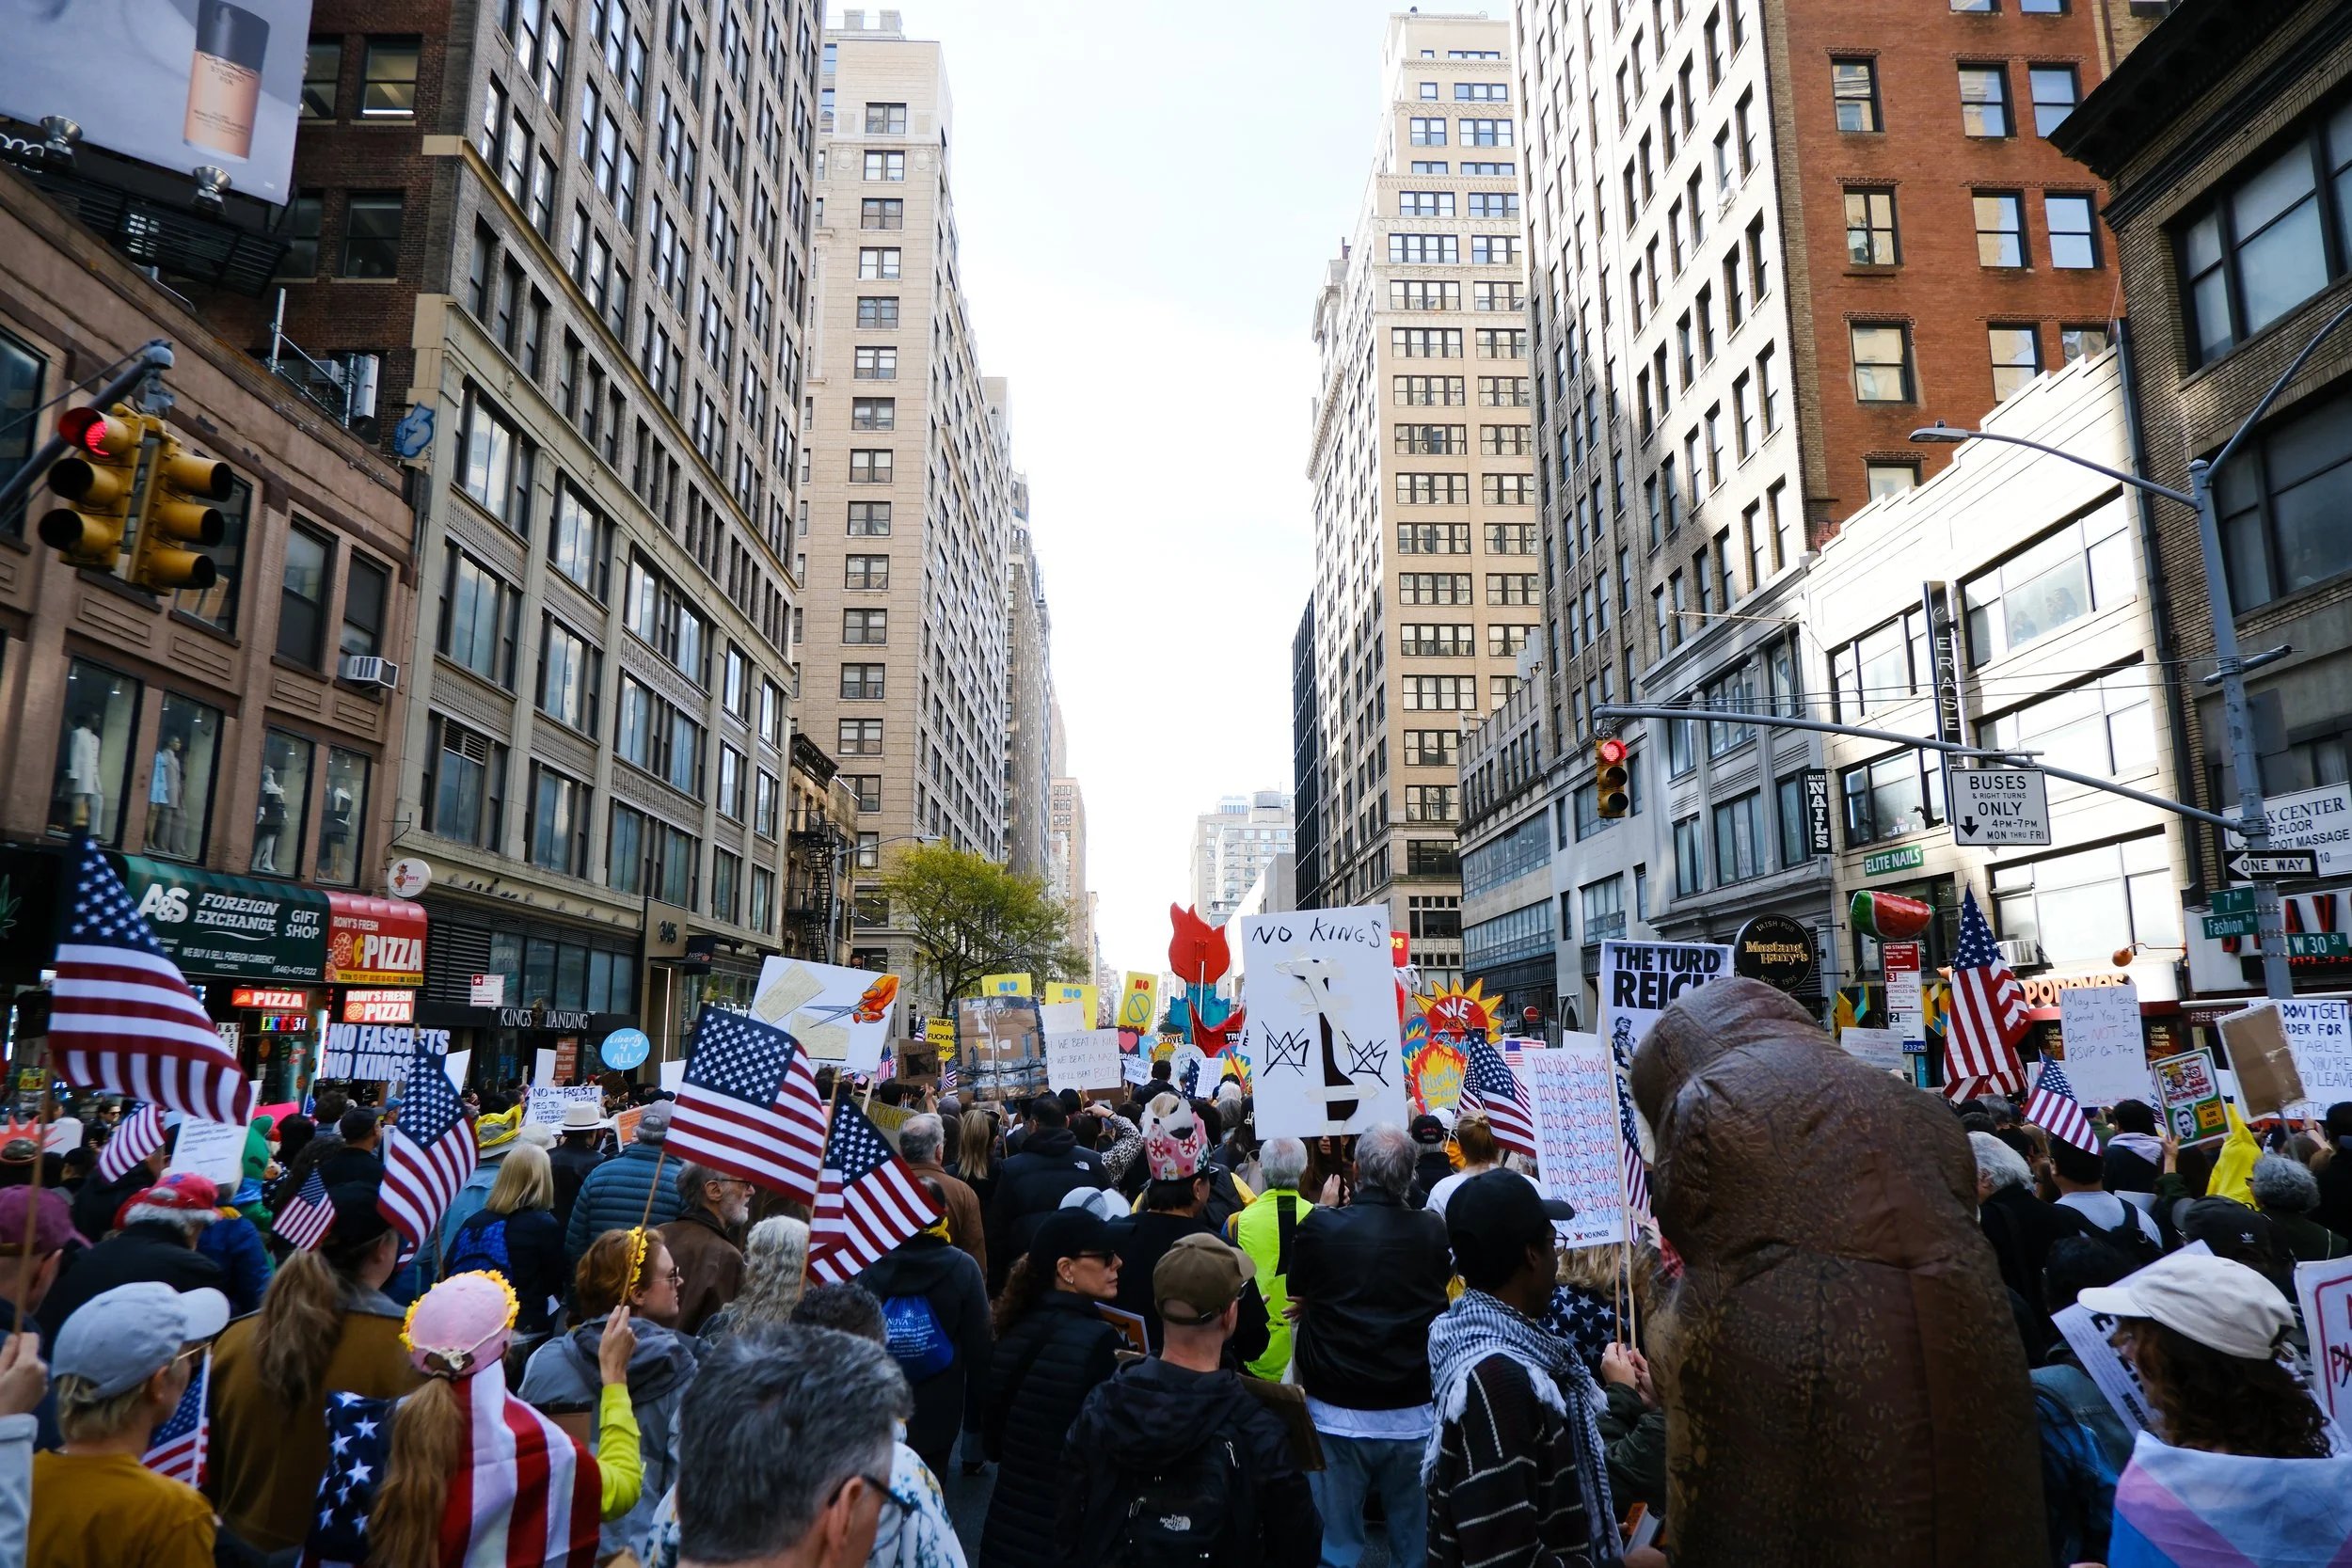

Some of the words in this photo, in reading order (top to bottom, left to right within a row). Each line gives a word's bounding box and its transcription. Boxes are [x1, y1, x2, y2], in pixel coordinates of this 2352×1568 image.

[1969, 776, 2026, 789] BUSES
[1808, 782, 1828, 848] NAILS
[1978, 801, 2022, 816] ONLY
[2279, 797, 2345, 821] CENTER
[1992, 819, 2037, 828] 4PM-7PM
[2279, 819, 2313, 833] FLOOR
[1987, 831, 2007, 839] MON
[2029, 831, 2044, 839] FRI
[2296, 829, 2350, 847] MASSAGE
[1866, 856, 1890, 873] ELITE
[1892, 847, 1920, 867] NAILS
[2241, 860, 2269, 871] ONE
[2276, 859, 2303, 871] WAY
[137, 883, 190, 924] A&S
[199, 893, 280, 916] FOREIGN
[2224, 894, 2231, 910] 7
[2234, 892, 2242, 901] Av
[194, 910, 278, 931] EXCHANGE
[291, 910, 320, 925] GIFT
[333, 916, 358, 929] RONY'S
[358, 918, 379, 931] FRESH
[2208, 916, 2244, 935] Fashion
[2246, 914, 2254, 924] Av
[285, 924, 320, 940] SHOP
[660, 920, 677, 943] 345
[1252, 926, 1293, 944] NO
[1310, 917, 1381, 948] KINGS
[1756, 921, 1777, 931] IRISH
[1781, 923, 1795, 932] PUB
[1745, 941, 1804, 954] Mustang
[2293, 937, 2304, 954] W
[2309, 937, 2327, 953] 30
[2331, 935, 2340, 944] St
[183, 946, 192, 957] WE
[193, 948, 205, 958] BUY
[205, 949, 210, 958] &
[211, 950, 224, 960] SELL
[225, 952, 247, 963] FOREIGN
[248, 954, 277, 965] CURRENCY
[362, 934, 422, 971] PIZZA
[1613, 946, 1654, 971] THE
[1658, 948, 1721, 973] TURD
[1760, 953, 1808, 965] Harry's
[1135, 979, 1149, 990] NO
[1760, 974, 1775, 985] NYC
[1782, 974, 1797, 985] 1995
[1888, 974, 1895, 982] 3
[998, 981, 1018, 991] NO
[1063, 989, 1082, 998] NO
[252, 991, 303, 1007] PIZZA
[346, 990, 380, 1002] RONY'S
[382, 990, 412, 1002] FRESH
[2061, 990, 2089, 1009] May
[2092, 990, 2101, 1005] I
[2109, 988, 2138, 1006] Please
[364, 1003, 410, 1021] PIZZA
[1436, 997, 1474, 1020] WE
[2282, 1004, 2318, 1020] DON'T
[2319, 1003, 2348, 1020] GET
[501, 1008, 532, 1027] KINGS
[546, 1010, 588, 1029] LANDING
[1891, 1013, 1898, 1022] 2
[2190, 1012, 2211, 1022] FREE
[1444, 1021, 1458, 1029] ARE
[2285, 1024, 2311, 1035] RDER
[2318, 1023, 2343, 1036] FOR
[327, 1023, 357, 1051] NO
[609, 1034, 644, 1048] Liberty
[2067, 1028, 2088, 1043] Does
[2092, 1025, 2118, 1041] NOT
[2122, 1026, 2140, 1040] Say
[1058, 1039, 1069, 1049] WE
[1072, 1037, 1089, 1047] BEAT
[1093, 1037, 1099, 1046] A
[2294, 1040, 2343, 1053] TABLE
[612, 1052, 643, 1067] ALL!
[1057, 1055, 1066, 1064] WE
[1070, 1054, 1086, 1063] BEAT
[1089, 1053, 1095, 1062] A
[2071, 1048, 2096, 1062] RSVP
[2101, 1047, 2110, 1056] On
[2116, 1045, 2134, 1054] The
[325, 1053, 353, 1079] NO
[353, 1053, 412, 1081] KINGS
[1533, 1055, 1553, 1073] We
[1554, 1054, 1570, 1076] the
[1569, 1053, 1607, 1074] People
[2308, 1056, 2352, 1070] YOU'RE
[1077, 1070, 1091, 1079] BEAT
[1094, 1067, 1119, 1080] BOTH
[533, 1087, 548, 1098] NO
[564, 1087, 595, 1099] FASCIST
[1536, 1084, 1556, 1101] We
[1558, 1084, 1574, 1103] the
[1572, 1082, 1610, 1101] People
[532, 1101, 547, 1110] YES
[1540, 1112, 1561, 1129] We
[1561, 1112, 1577, 1131] the
[1576, 1109, 1613, 1130] People
